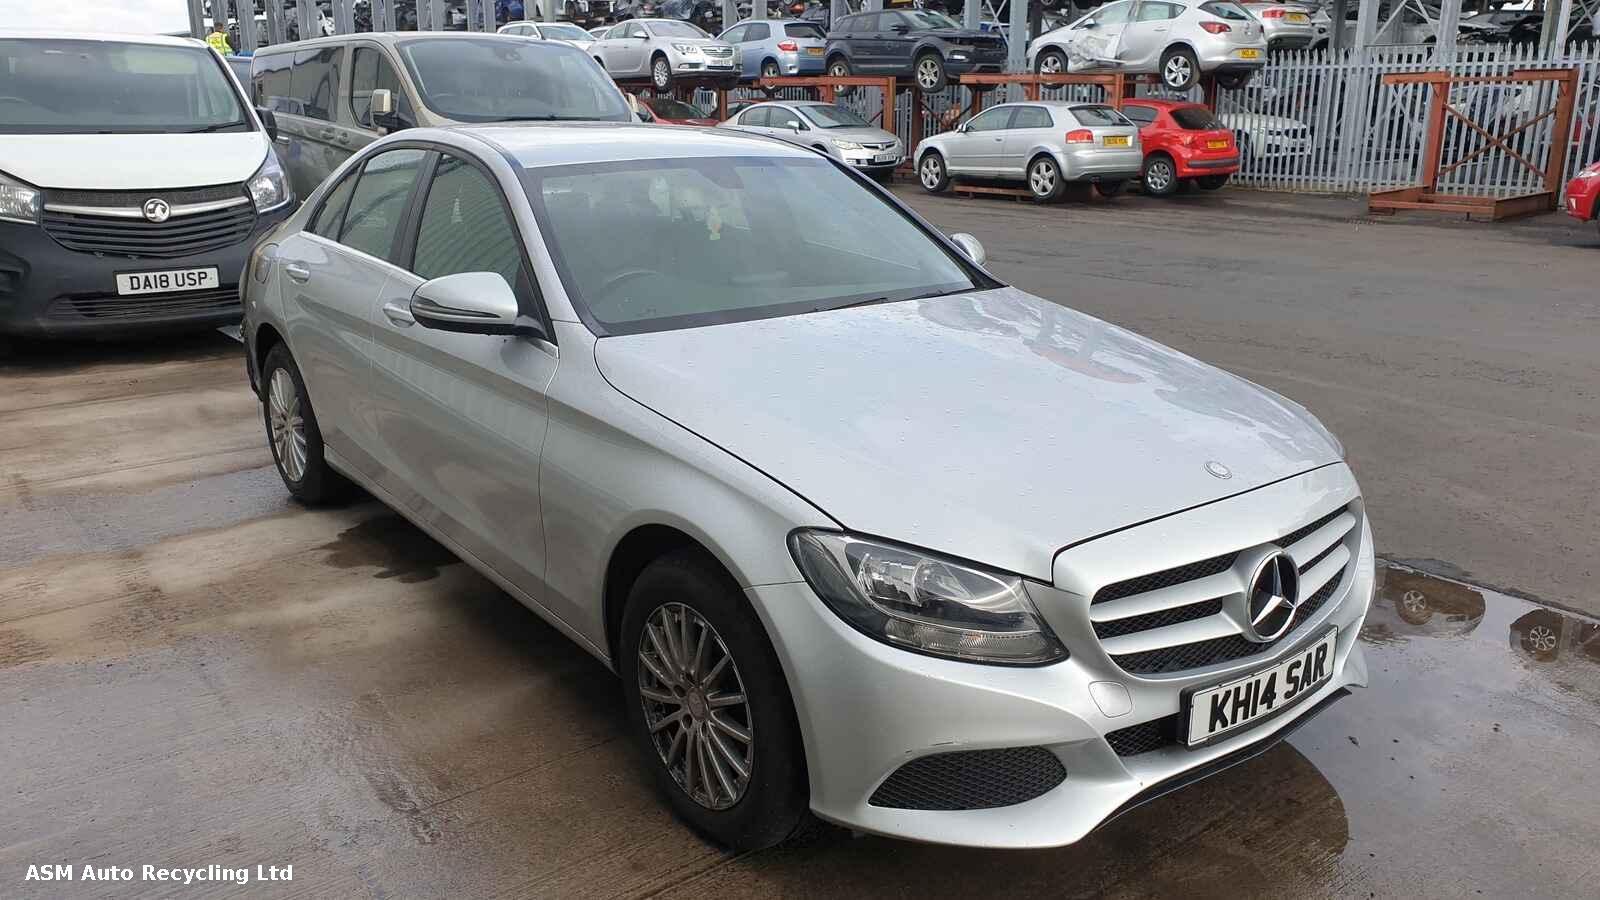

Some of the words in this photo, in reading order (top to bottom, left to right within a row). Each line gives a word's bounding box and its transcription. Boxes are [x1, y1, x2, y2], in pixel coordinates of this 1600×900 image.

[129, 274, 169, 290] DA18
[175, 272, 207, 287] USP
[1209, 672, 1277, 732] KH14
[1284, 643, 1328, 699] SAR
